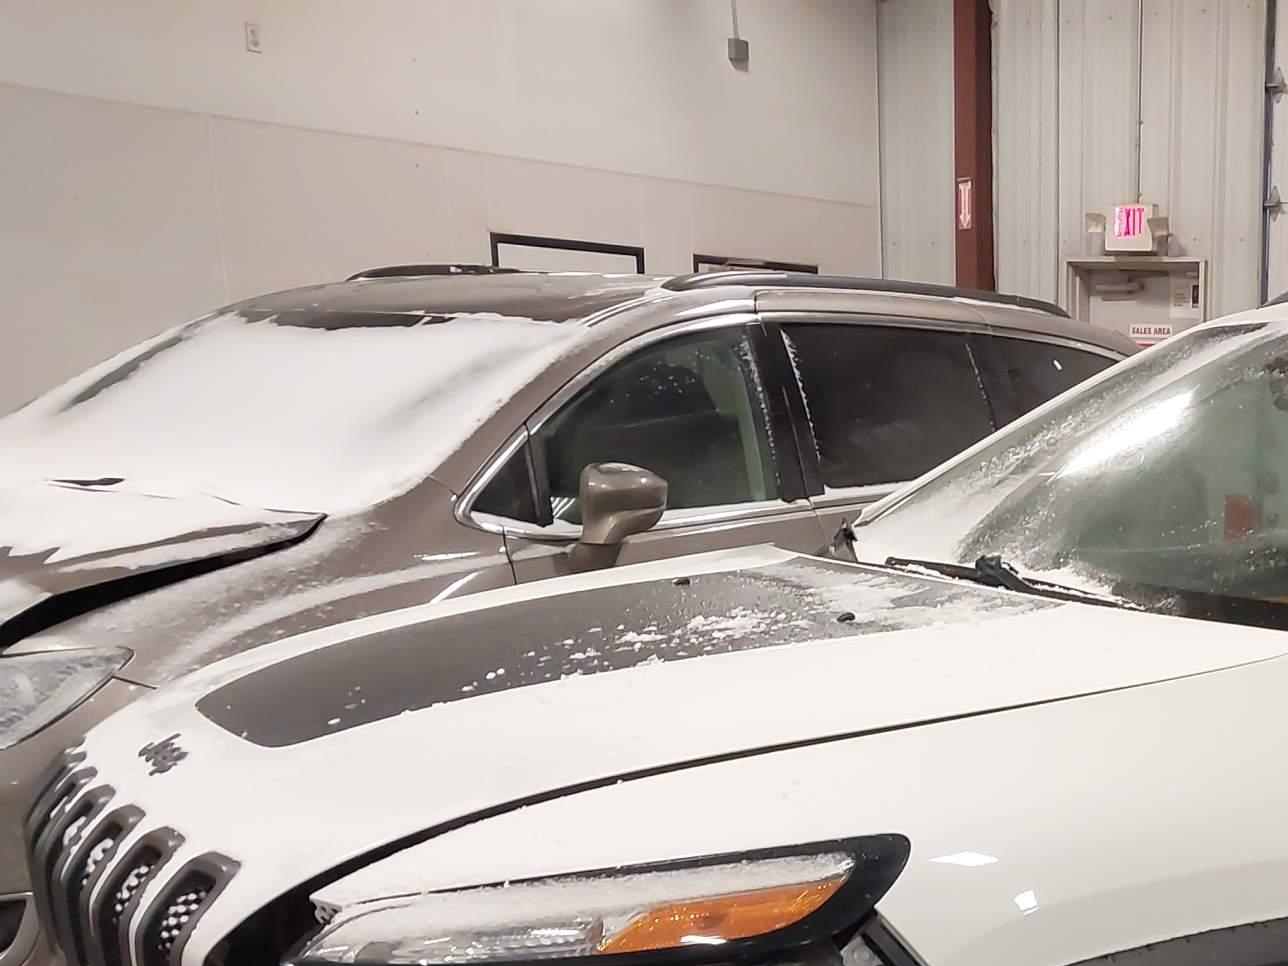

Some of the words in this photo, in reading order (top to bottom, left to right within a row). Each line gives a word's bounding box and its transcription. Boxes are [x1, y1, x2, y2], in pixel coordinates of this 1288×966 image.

[1113, 207, 1145, 237] EXIT
[1131, 327, 1152, 335] SALES
[1153, 327, 1171, 336] AREA
